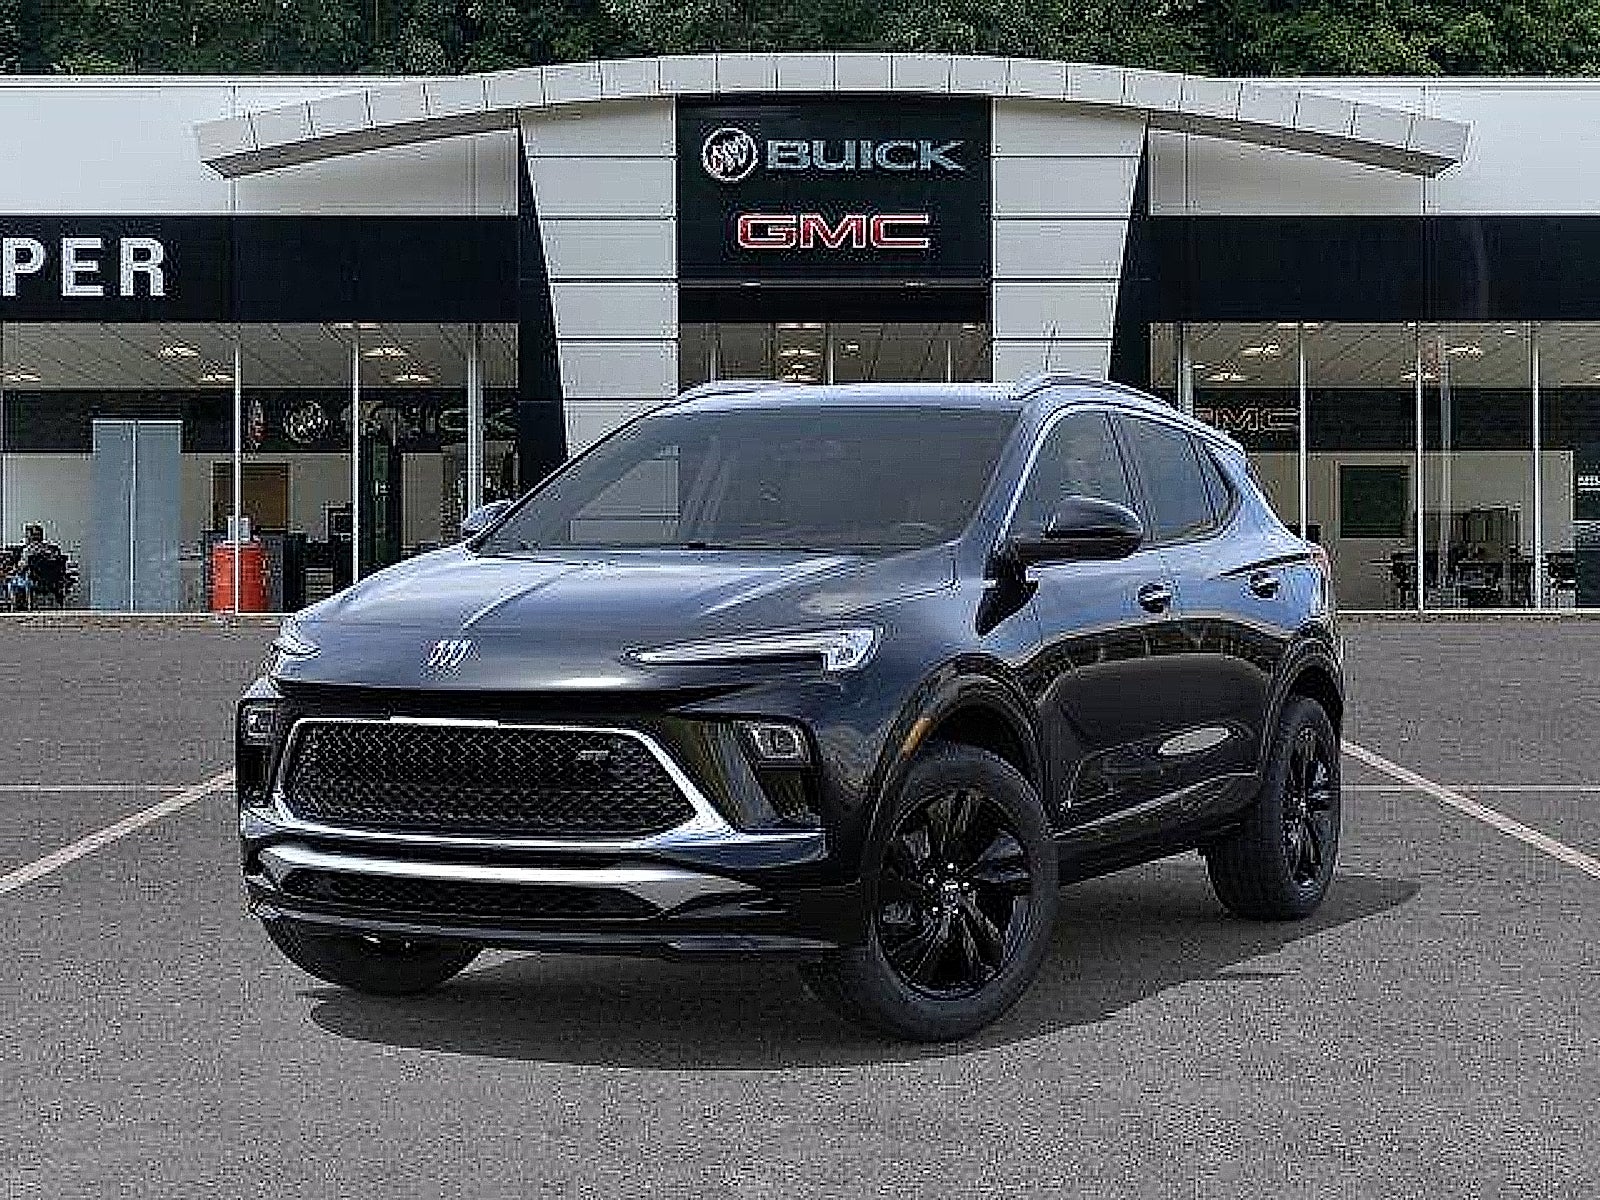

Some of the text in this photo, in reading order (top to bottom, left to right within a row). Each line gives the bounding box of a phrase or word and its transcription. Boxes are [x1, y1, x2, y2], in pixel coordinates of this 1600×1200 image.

[767, 140, 964, 170] BUICK
[738, 214, 929, 248] GMC
[2, 237, 165, 296] PER
